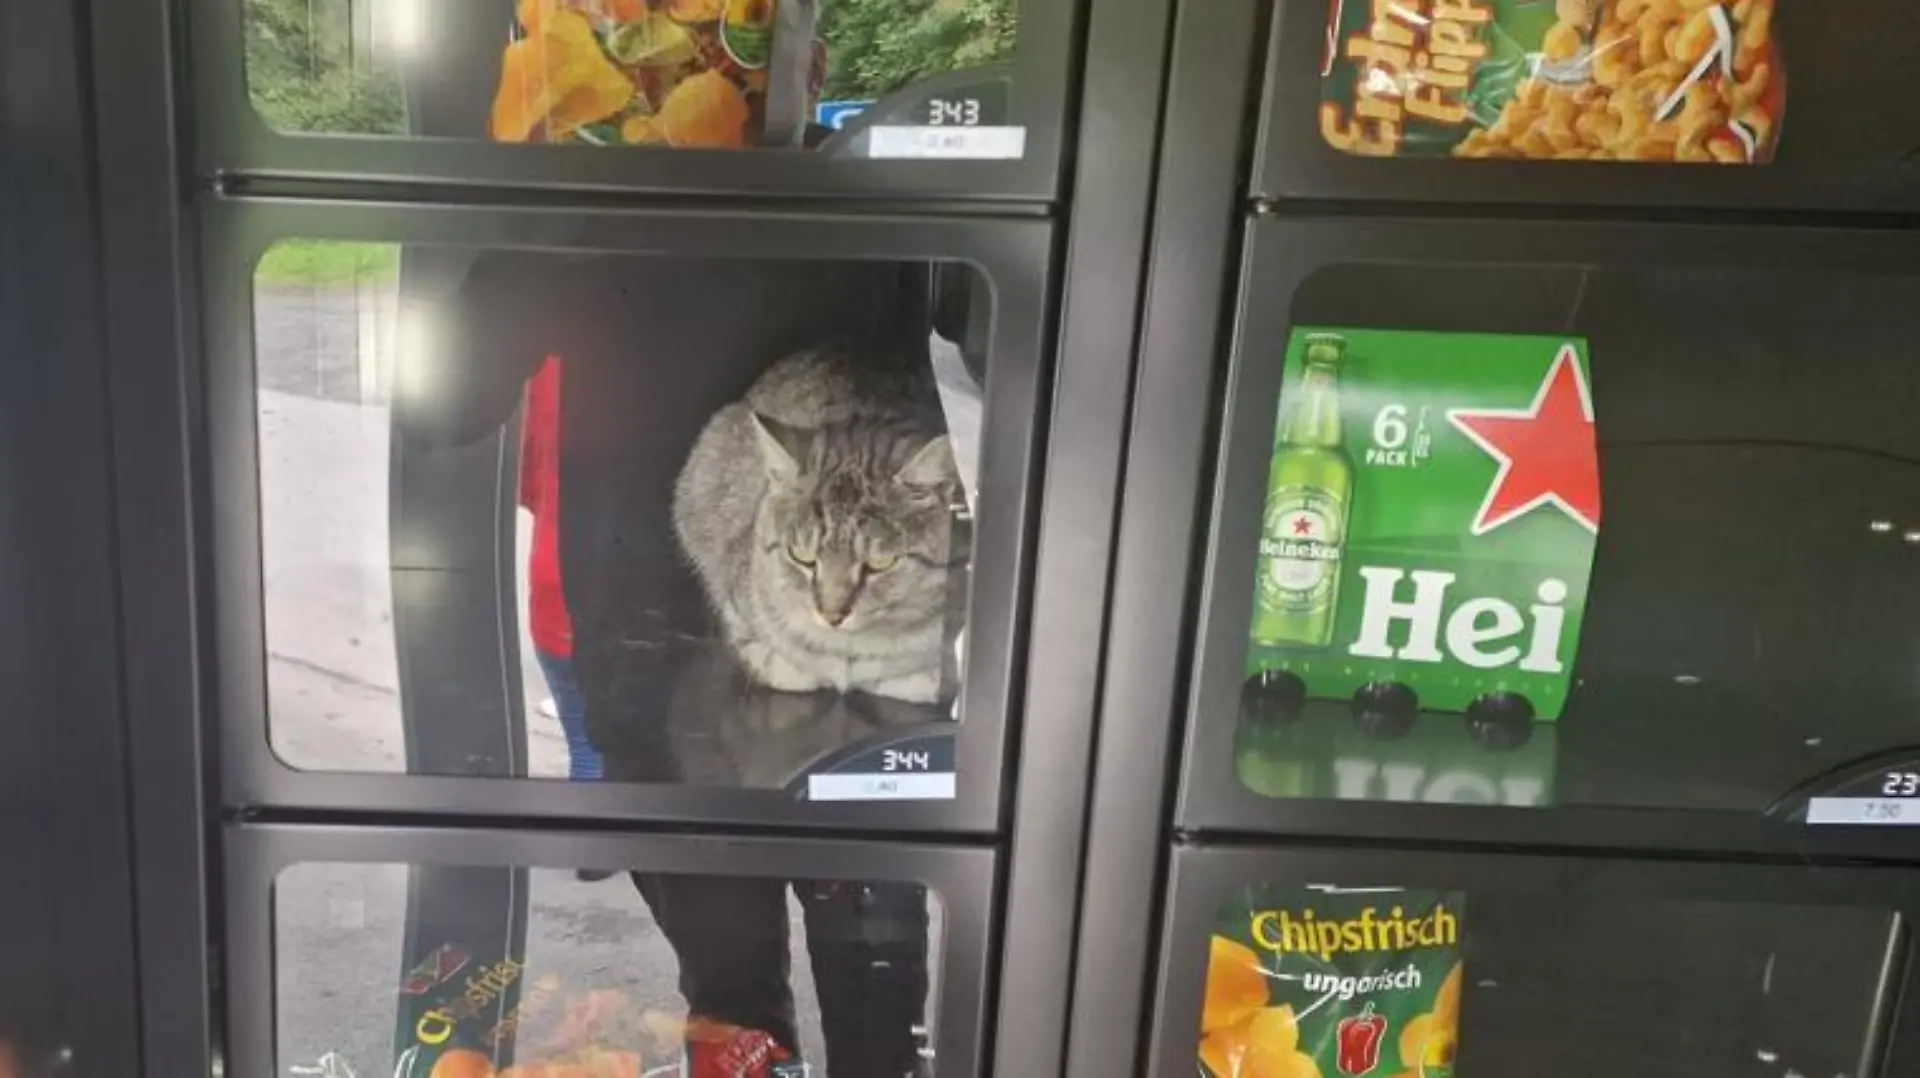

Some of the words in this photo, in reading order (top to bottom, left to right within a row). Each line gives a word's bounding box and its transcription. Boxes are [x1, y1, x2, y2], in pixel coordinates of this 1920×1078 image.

[928, 99, 980, 126] 343
[1373, 403, 1408, 448] 6
[1365, 448, 1408, 466] PACK
[1349, 565, 1568, 673] Hei
[882, 749, 929, 771] 344
[1882, 771, 1920, 796] 23
[1251, 902, 1457, 963] Chipsfrisch
[1303, 963, 1422, 1001] ungarisch
